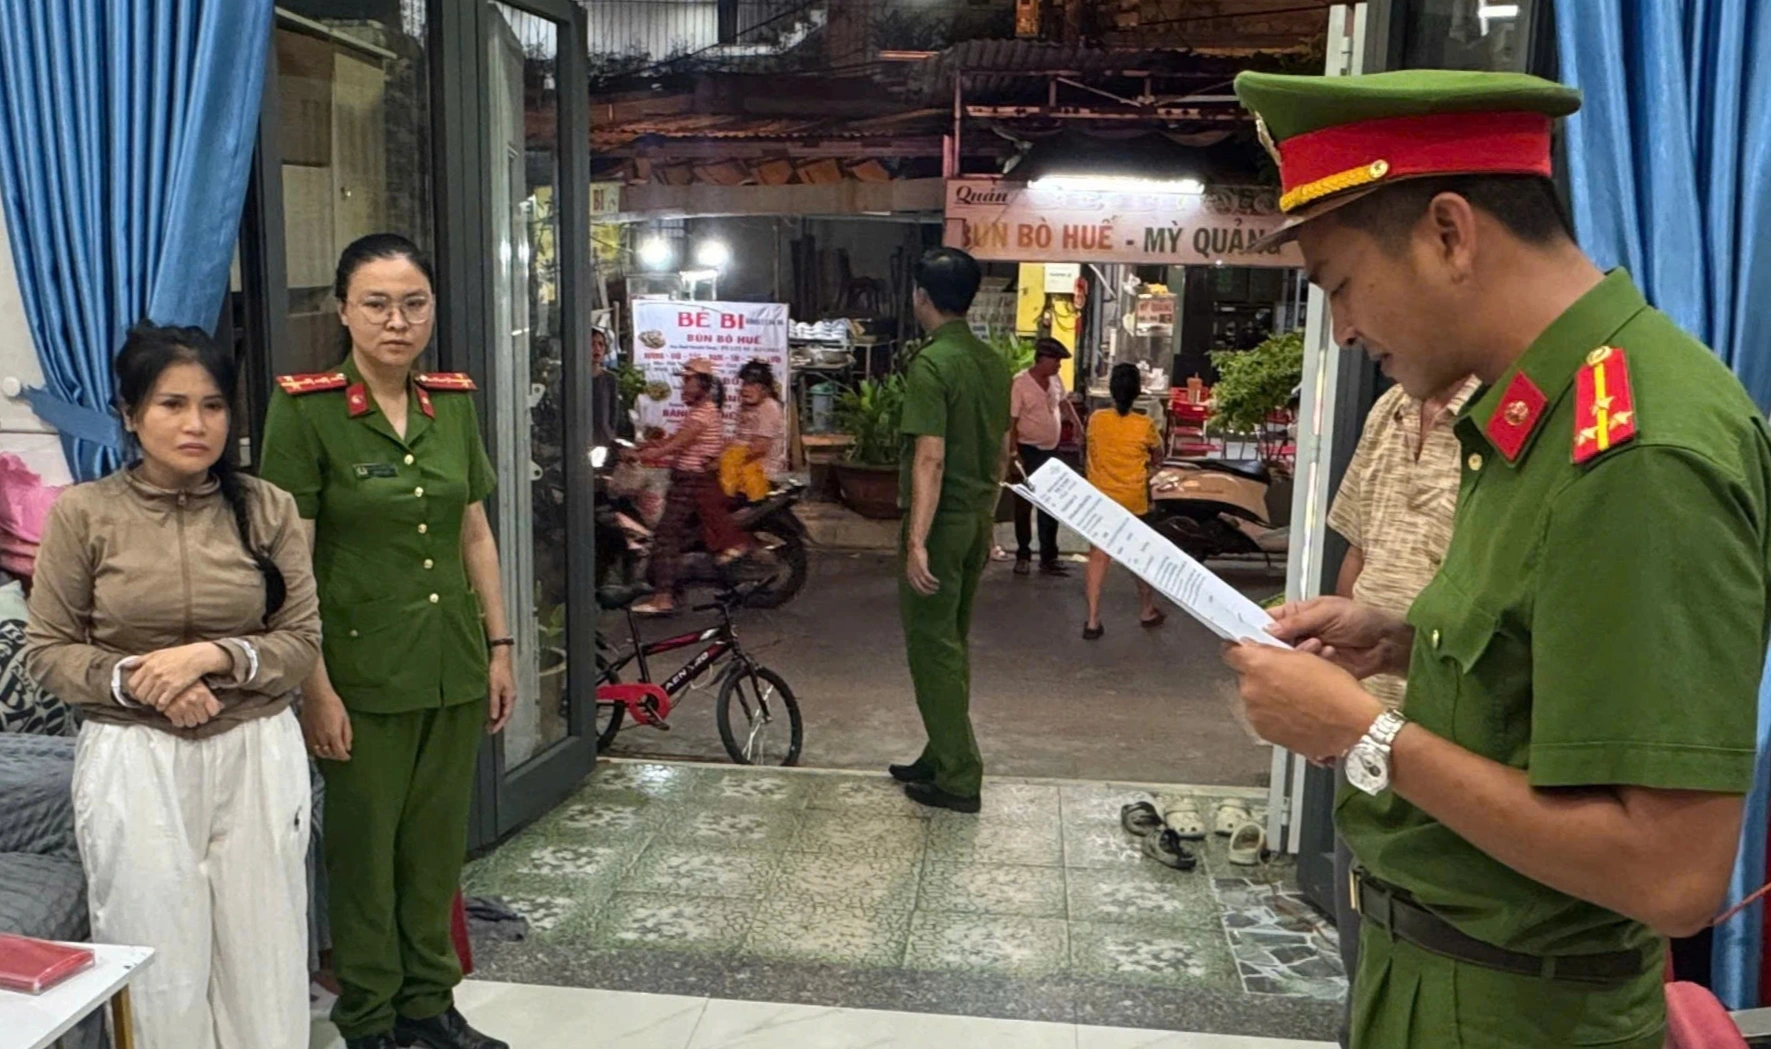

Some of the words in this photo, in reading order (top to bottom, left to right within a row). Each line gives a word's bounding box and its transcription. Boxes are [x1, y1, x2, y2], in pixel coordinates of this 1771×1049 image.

[1018, 216, 1051, 249] BÒ
[1063, 214, 1118, 250] HUẾ
[1143, 220, 1182, 253] MỲ
[720, 313, 745, 329] BI
